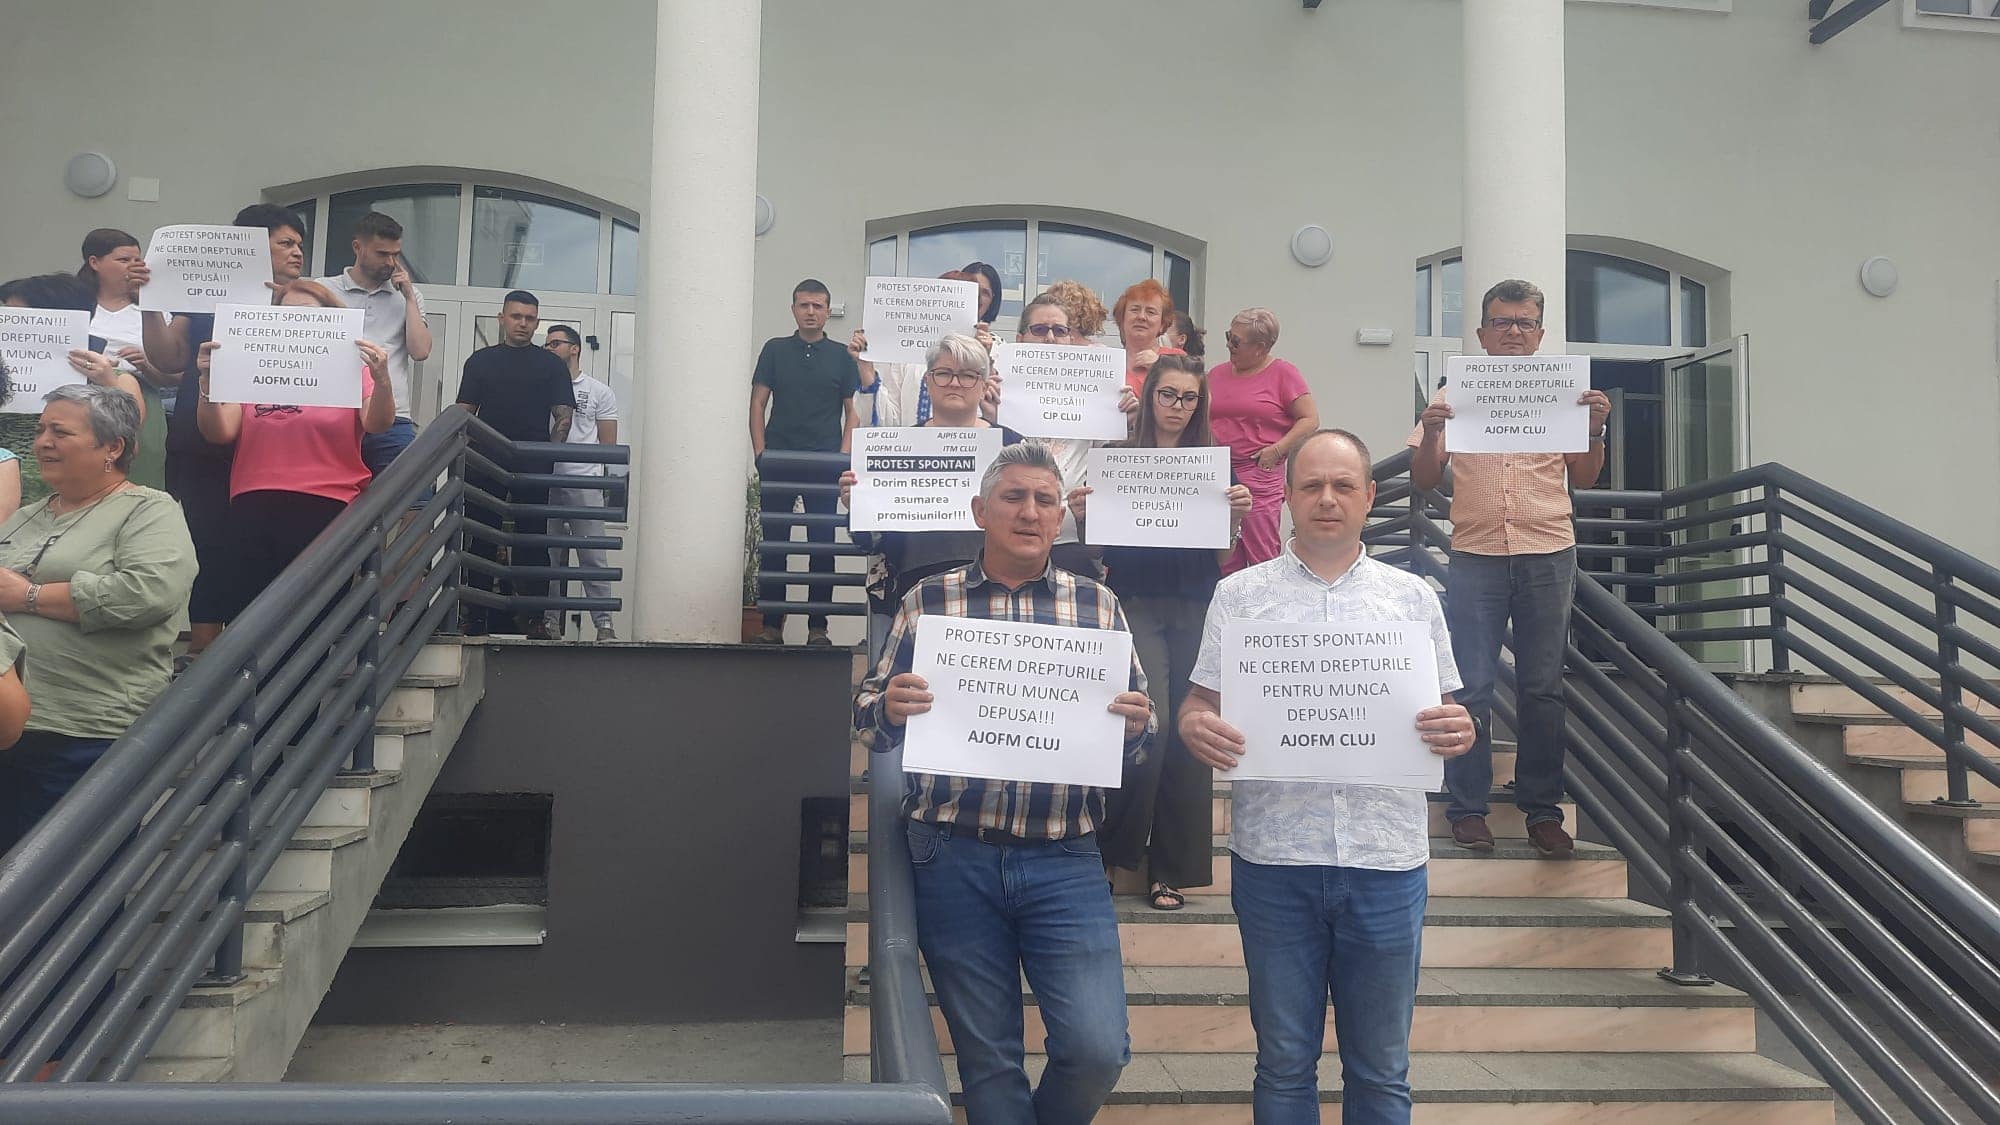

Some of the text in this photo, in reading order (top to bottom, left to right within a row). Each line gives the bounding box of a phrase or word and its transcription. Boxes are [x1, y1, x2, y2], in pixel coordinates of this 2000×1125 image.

[197, 232, 251, 240] SPONTAN!!!
[201, 247, 256, 256] DREPTURILE
[167, 259, 242, 269] PENTRU MUNCA
[913, 285, 962, 294] SPONTAN!!!
[886, 298, 913, 306] CEREM
[916, 300, 965, 308] DREPTURILE
[234, 312, 344, 323] PROTEST SPONTAN!!!
[886, 312, 951, 321] PENTRU MUNCA
[2, 333, 70, 344] DREPTURILE
[228, 328, 346, 340] NE CEREM DREPTURILE
[244, 344, 329, 354] PENTRU MUNCA
[7, 350, 52, 360] MUNCA
[1016, 351, 1111, 362] PROTEST SPONTAN!!!
[259, 359, 312, 369] DEPUSA!!!
[1466, 363, 1572, 372] PROTEST SPONTAN!!!
[1012, 366, 1114, 379] NE CEREM DREPTURILE
[253, 376, 318, 387] AJOFM CLUJ
[1026, 381, 1098, 392] PENTRU MUNCA
[1515, 380, 1574, 388] DREPTURILE
[10, 383, 36, 392] CLUJ
[1476, 395, 1557, 403] PENTRU MUNCA
[1043, 412, 1081, 422] CJP CLUJ
[1491, 410, 1541, 418] DEPUSA!!!
[1485, 426, 1546, 434] AJOFM CLUJ
[867, 460, 975, 469] PROTEST SPONTAN!
[1106, 455, 1212, 464] PROTEST SPONTAN!!!
[1118, 471, 1152, 479] CEREM
[1156, 472, 1216, 480] DREPTURILE
[873, 478, 970, 487] Dorim RESPECT si
[1118, 486, 1199, 495] PENTRU MUNCA
[1132, 500, 1183, 511] DEPUSĂ!!!
[878, 511, 966, 521] promisiunilor!!!
[1136, 518, 1178, 527] CJP CLUJ
[946, 628, 1103, 655] PROTEST SPONTAN!!!
[1245, 632, 1403, 648] PROTEST SPONTAN!!!
[937, 653, 1106, 681] NE CEREM DREPTURILE
[1239, 658, 1412, 674] NE CEREM DREPTURILE
[959, 679, 1079, 702] PENTRU MUNCA
[1263, 682, 1390, 698] PENTRU MUNCA
[978, 705, 1055, 725] DEPUSA!!!
[1288, 707, 1366, 722] DEPUSA!!!
[968, 730, 1060, 751] AJOFM CLUJ
[1280, 733, 1376, 747] AJOFM CLUJ
